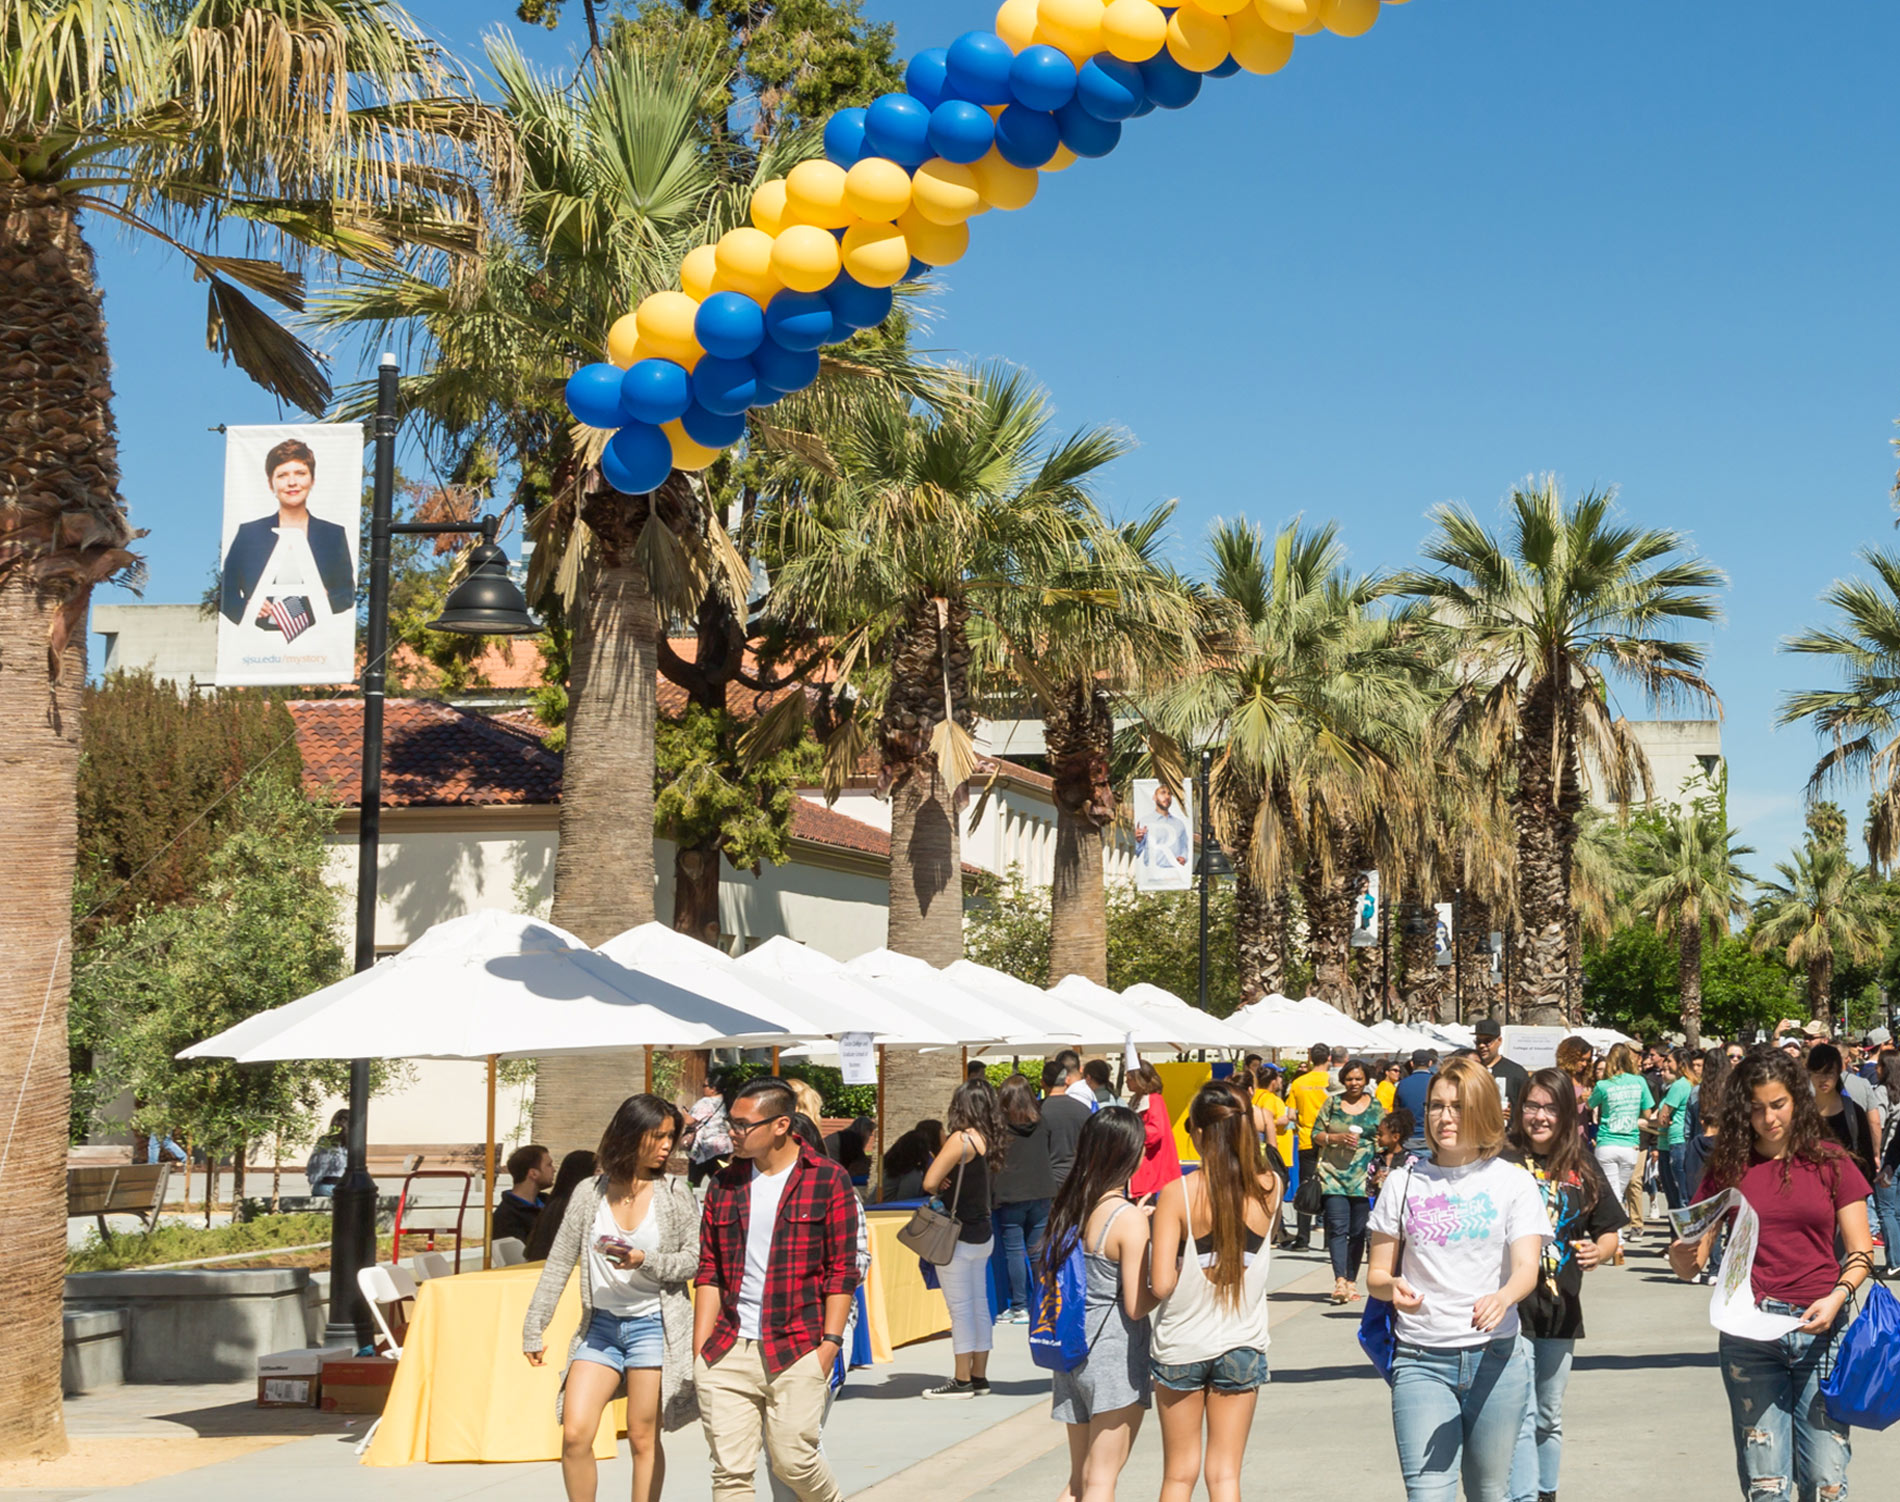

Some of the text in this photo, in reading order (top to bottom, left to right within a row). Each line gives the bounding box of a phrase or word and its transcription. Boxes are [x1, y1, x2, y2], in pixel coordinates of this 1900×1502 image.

[242, 655, 328, 666] sjsu.edu/mystory
[1143, 822, 1180, 868] R
[1470, 1198, 1487, 1216] 5K
